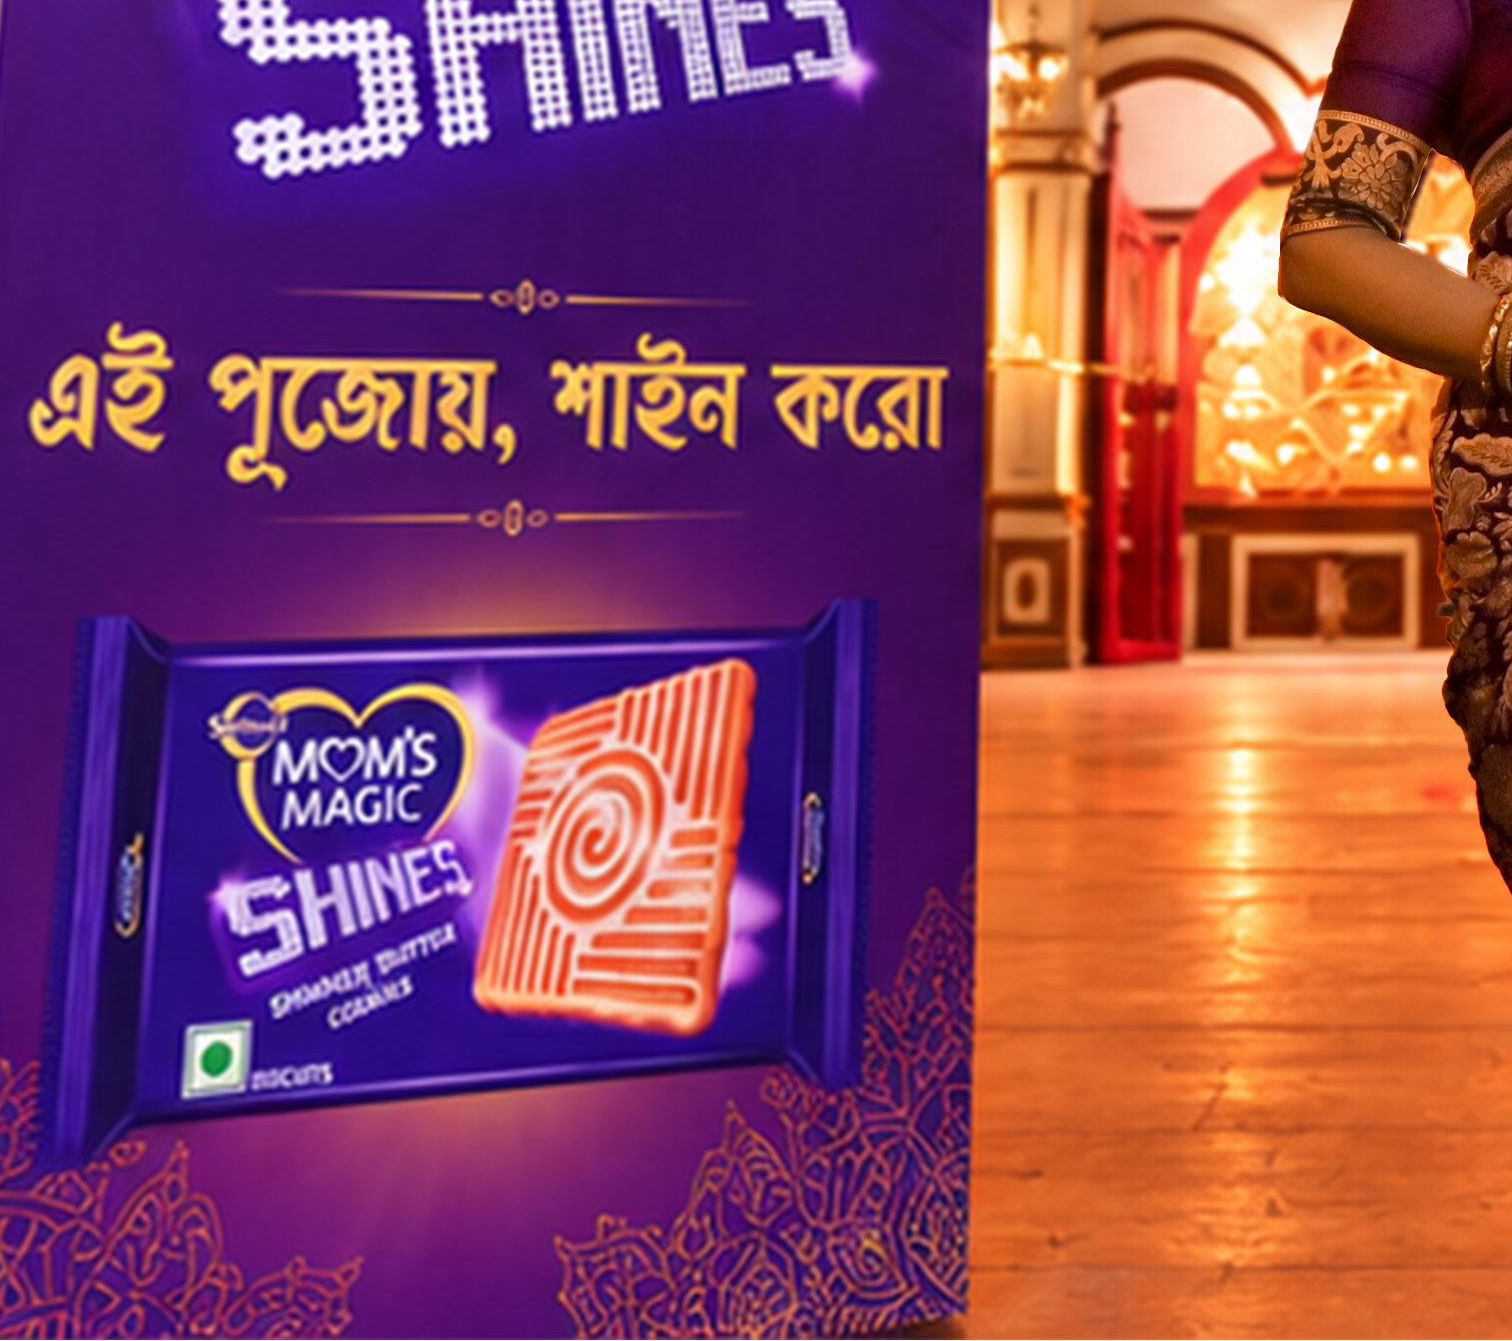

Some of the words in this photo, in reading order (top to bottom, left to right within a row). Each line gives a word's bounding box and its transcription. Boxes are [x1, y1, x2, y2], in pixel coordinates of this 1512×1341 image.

[29, 322, 174, 452] এই
[209, 355, 516, 490] পূজোয়,
[550, 333, 746, 450] শাইন
[770, 364, 949, 450] করো
[272, 725, 437, 786] MOM'S
[281, 783, 423, 830] MAGIC
[228, 839, 473, 977] SHINES
